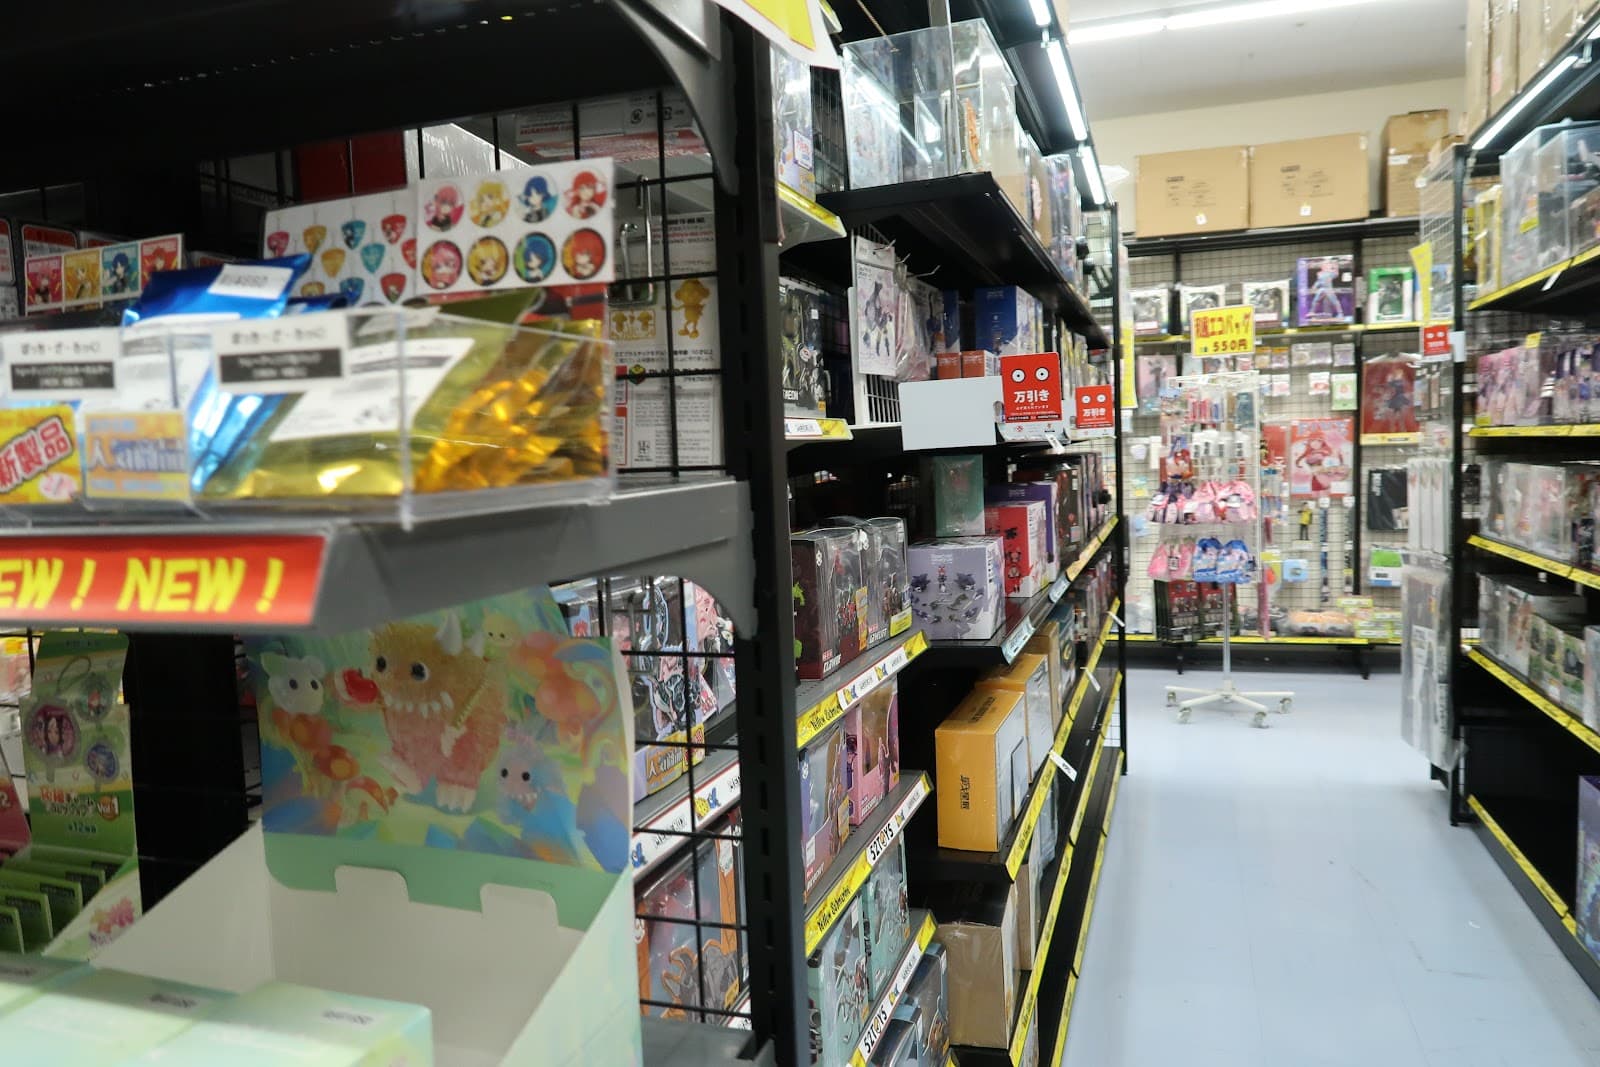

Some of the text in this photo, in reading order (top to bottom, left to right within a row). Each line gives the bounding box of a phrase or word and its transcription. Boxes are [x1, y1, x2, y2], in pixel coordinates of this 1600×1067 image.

[1014, 389, 1050, 403] 万引き
[1082, 408, 1106, 417] 万引き
[0, 417, 70, 489] 新製品
[869, 823, 894, 861] 52TOYS
[863, 1005, 888, 1054] 52TOYS
